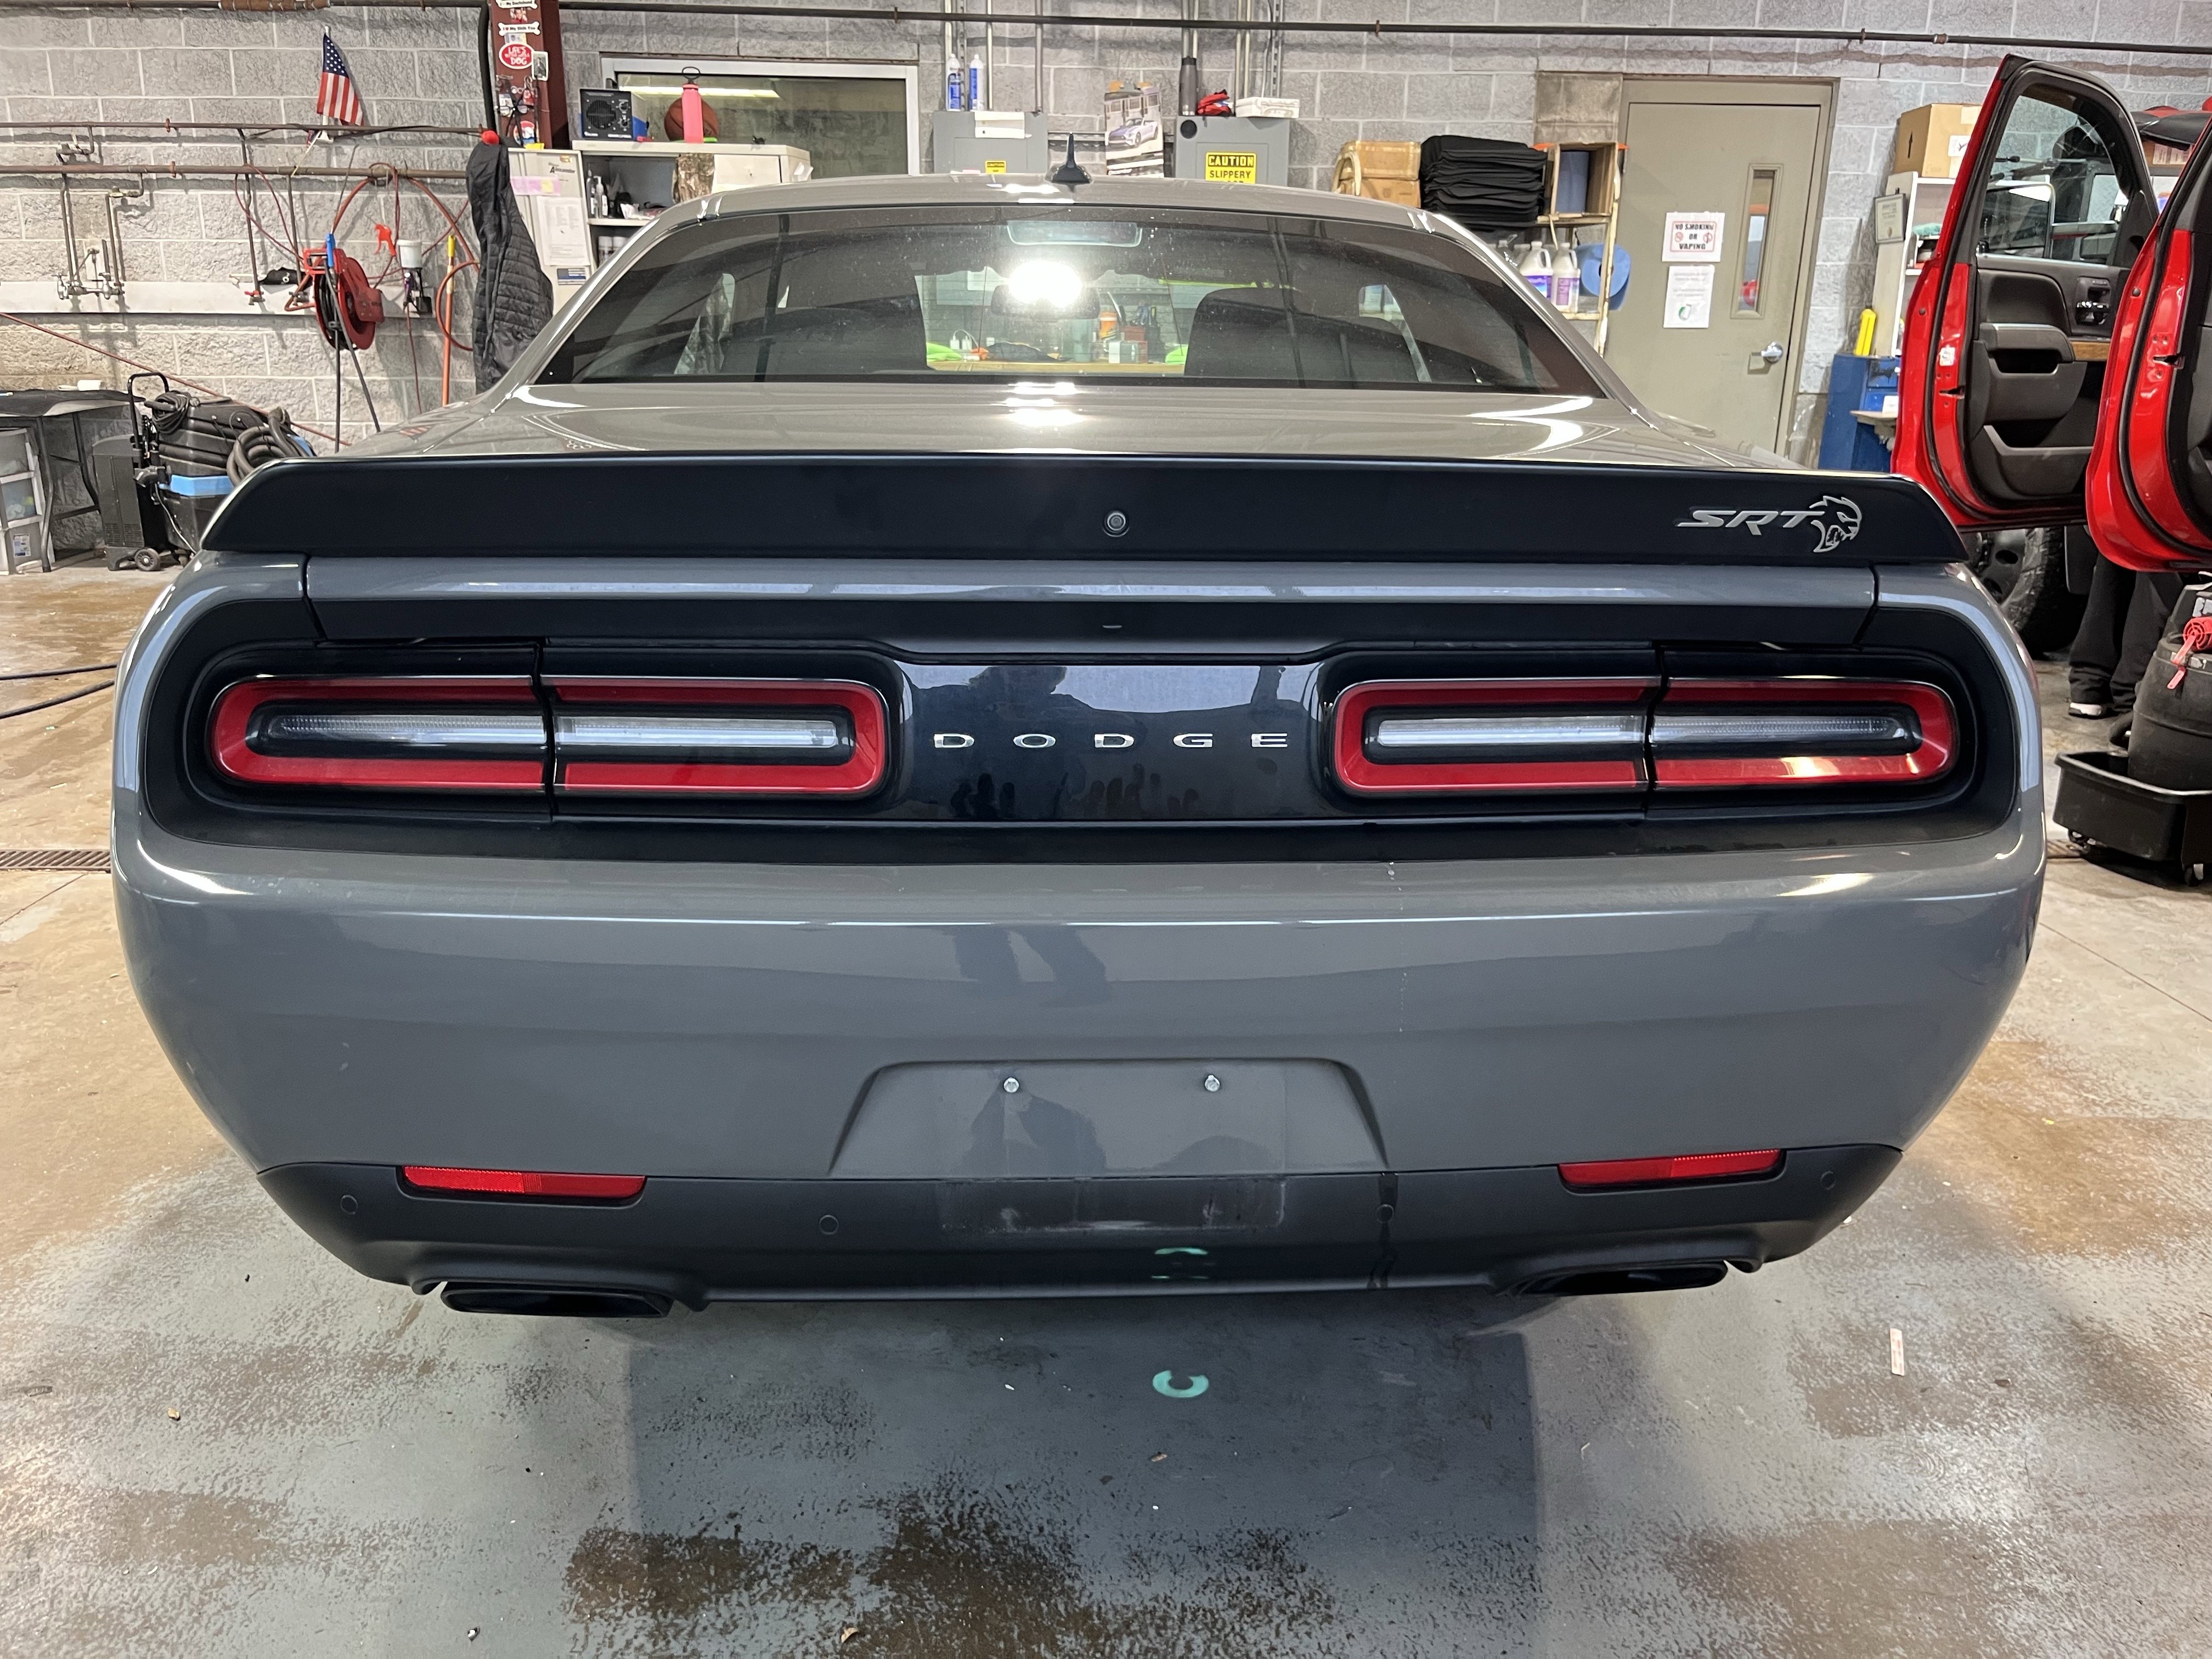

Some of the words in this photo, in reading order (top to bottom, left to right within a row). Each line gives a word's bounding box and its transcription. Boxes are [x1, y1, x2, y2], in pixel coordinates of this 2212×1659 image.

[1209, 155, 1254, 166] CAUTION
[1210, 170, 1251, 178] SLIPPERY
[1677, 510, 1825, 535] SRT
[934, 733, 1288, 748] DODGE
